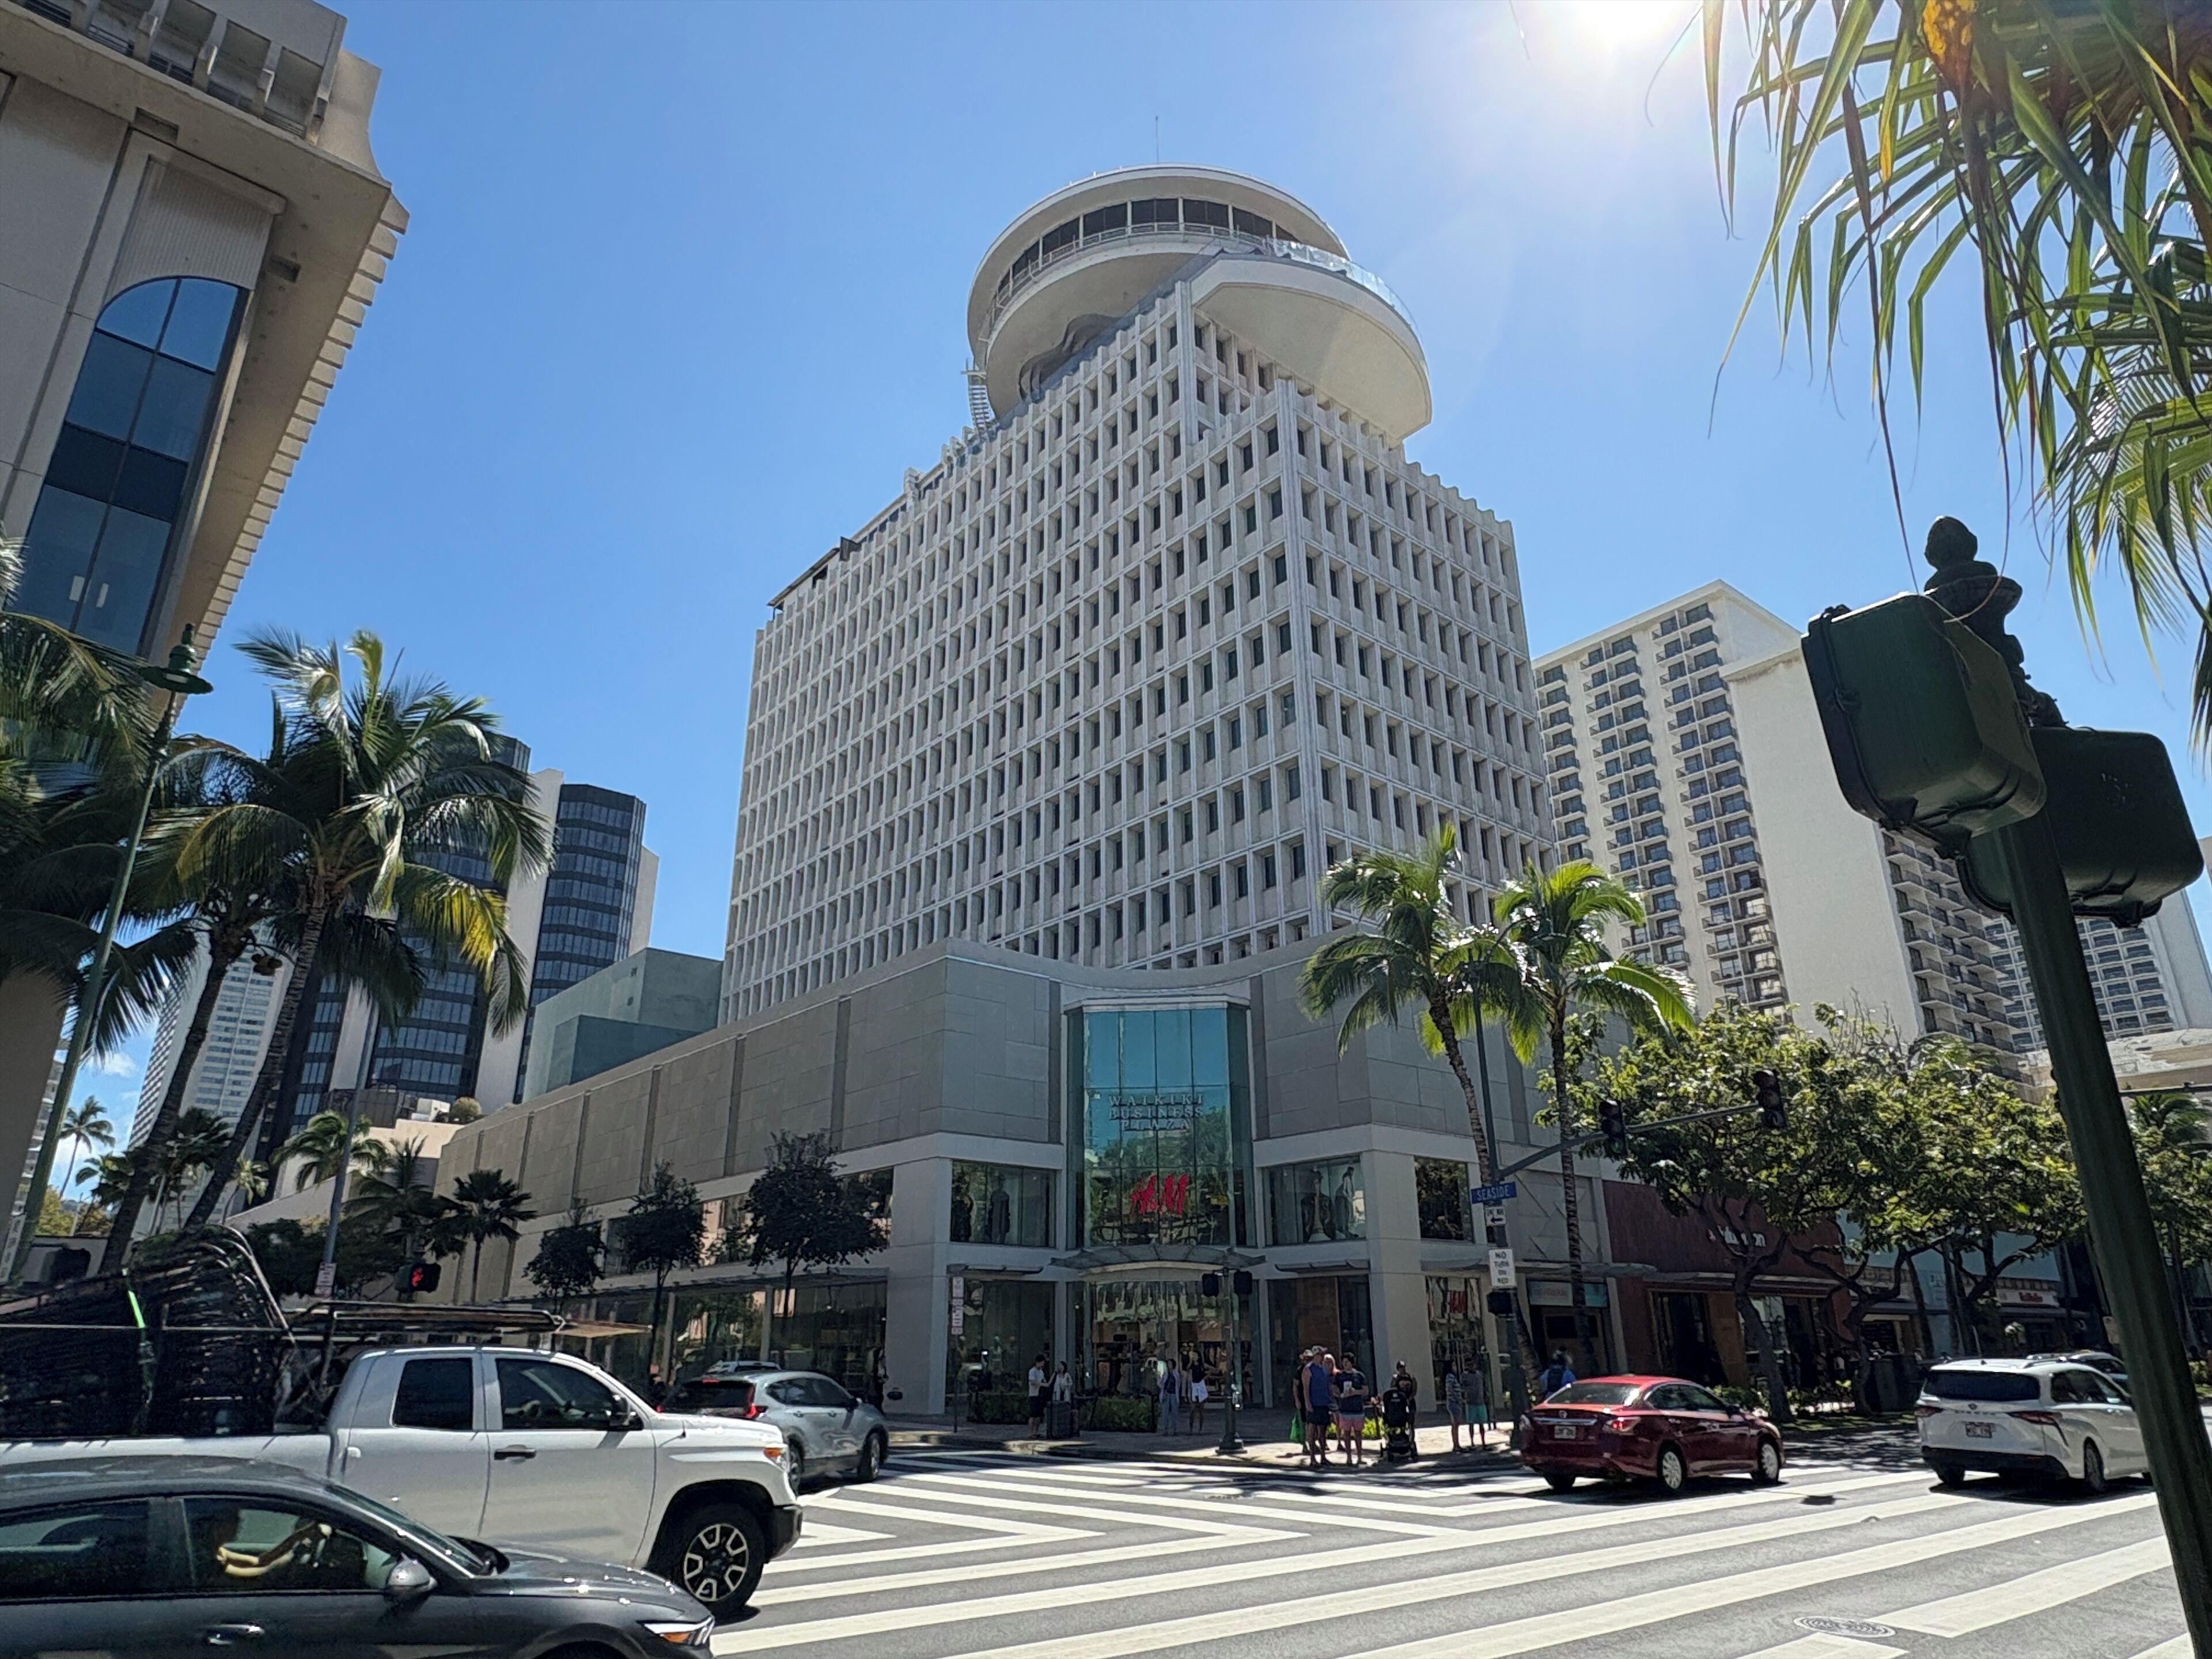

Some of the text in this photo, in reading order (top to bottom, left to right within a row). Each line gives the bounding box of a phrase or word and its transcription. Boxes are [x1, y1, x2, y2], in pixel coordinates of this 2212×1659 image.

[1108, 1094, 1203, 1106] WAIKIKI
[1108, 1105, 1203, 1119] BUSINESS
[1121, 1119, 1190, 1130] PLAZA
[1130, 1173, 1188, 1216] H&M
[1477, 1184, 1510, 1202] SEASIDE
[1495, 1251, 1506, 1259] NO
